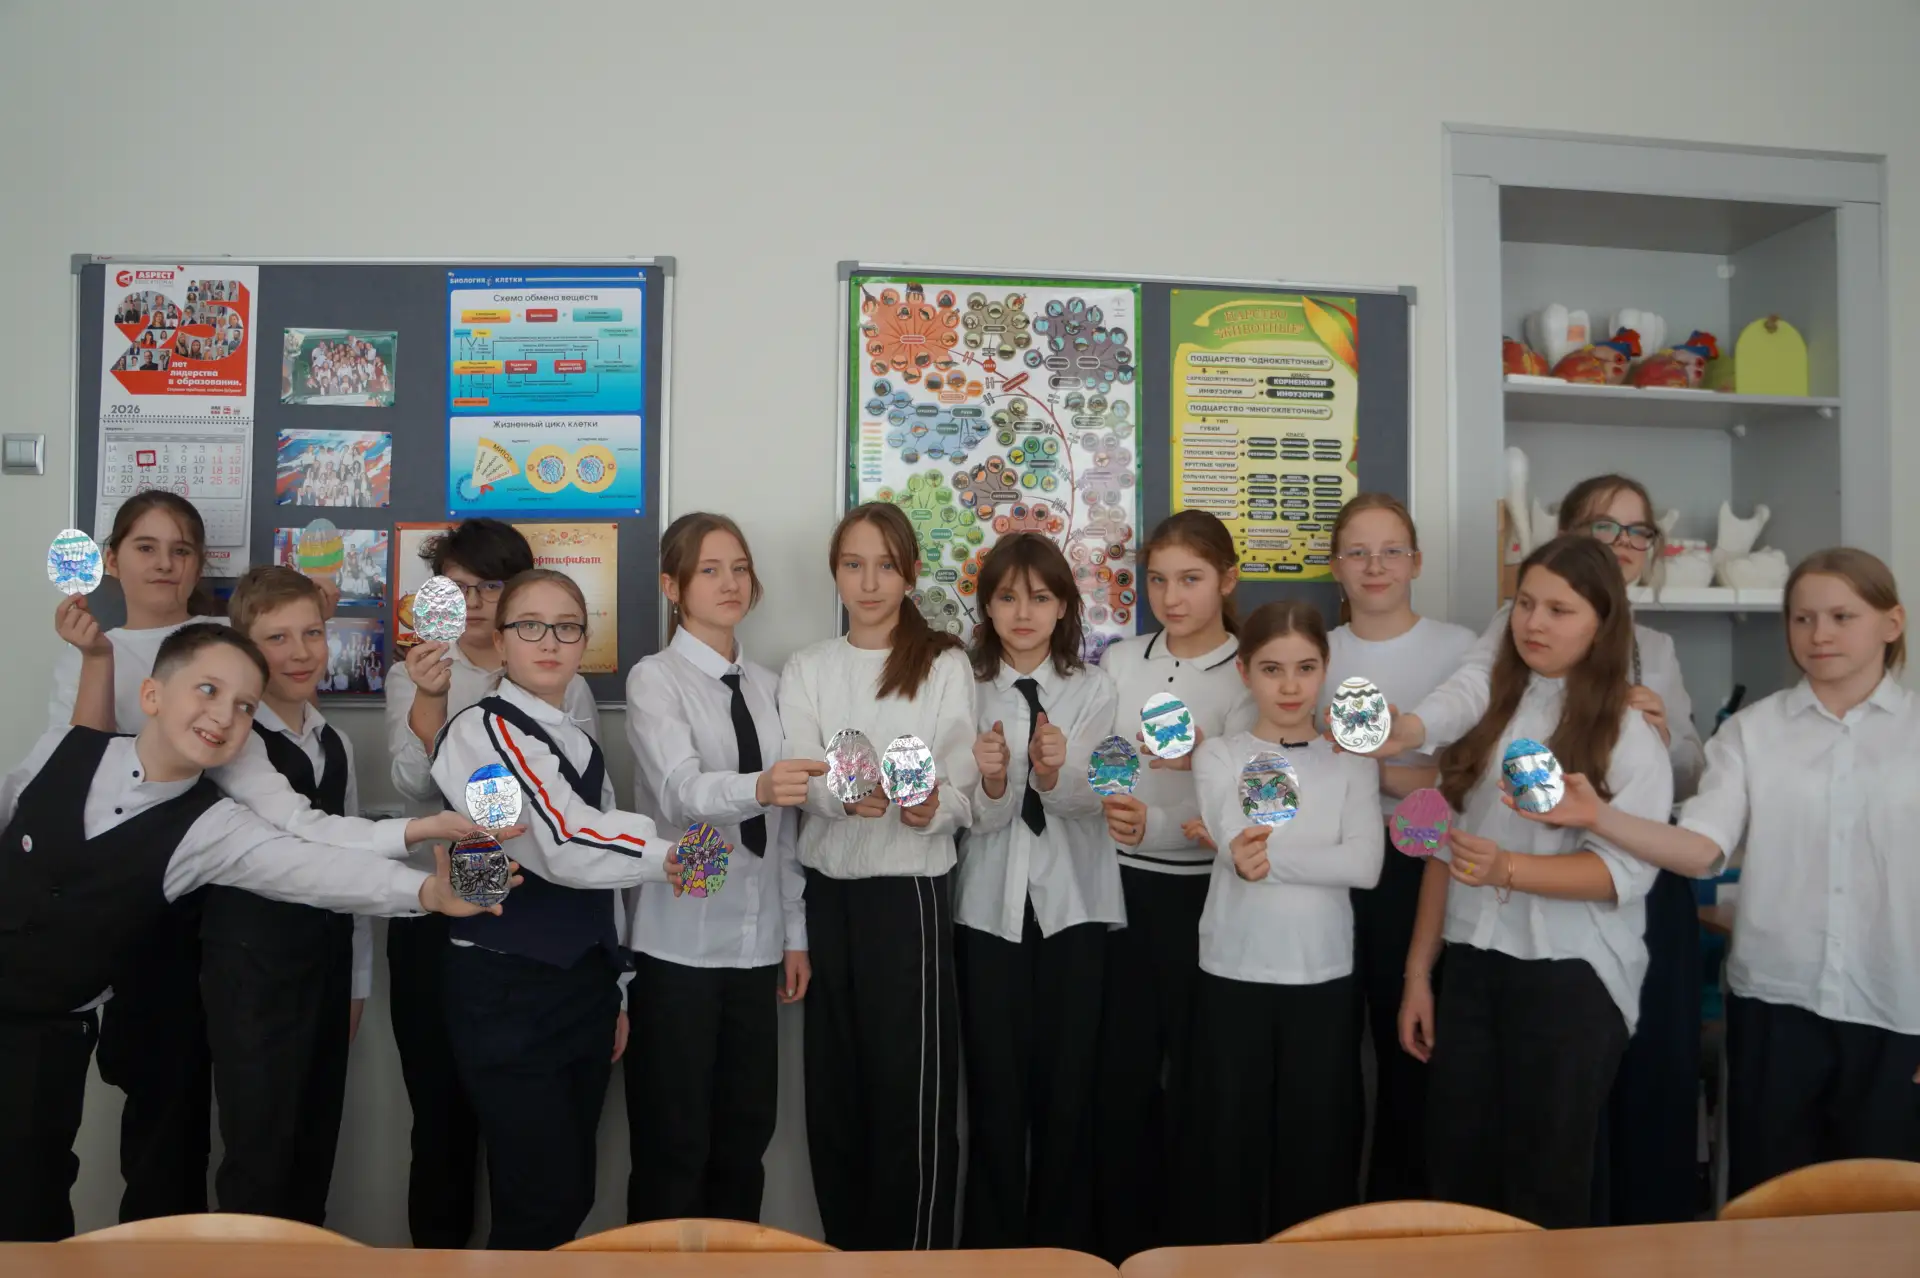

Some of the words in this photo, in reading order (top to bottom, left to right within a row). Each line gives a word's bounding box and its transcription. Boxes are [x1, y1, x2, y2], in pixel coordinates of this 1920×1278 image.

[493, 294, 522, 302] Схема
[526, 293, 559, 302] обмена
[561, 294, 598, 303] веществ
[1224, 308, 1288, 322] ЦАРСТВО
[1191, 355, 1246, 364] ПОДЦАРСТВО
[170, 370, 218, 378] лидерства
[176, 377, 242, 387] образовании.
[111, 404, 141, 414] 2026
[1190, 404, 1244, 413] ПОДЦАРСТВО
[493, 420, 542, 428] Жизненный
[181, 444, 188, 453] 2
[200, 445, 206, 453] 3
[492, 444, 513, 462] МИТОЗ
[163, 455, 169, 463] 8
[180, 455, 187, 463] 9
[194, 455, 206, 464] 10
[120, 464, 133, 473] 13
[158, 465, 169, 474] 15
[176, 465, 187, 474] 16
[194, 466, 204, 474] 17
[212, 466, 223, 474] 18
[120, 475, 134, 484] 20
[156, 476, 169, 484] 22
[193, 476, 204, 485] 24
[120, 485, 132, 494] 27
[175, 486, 187, 494] 30
[533, 556, 602, 566] ертификат
